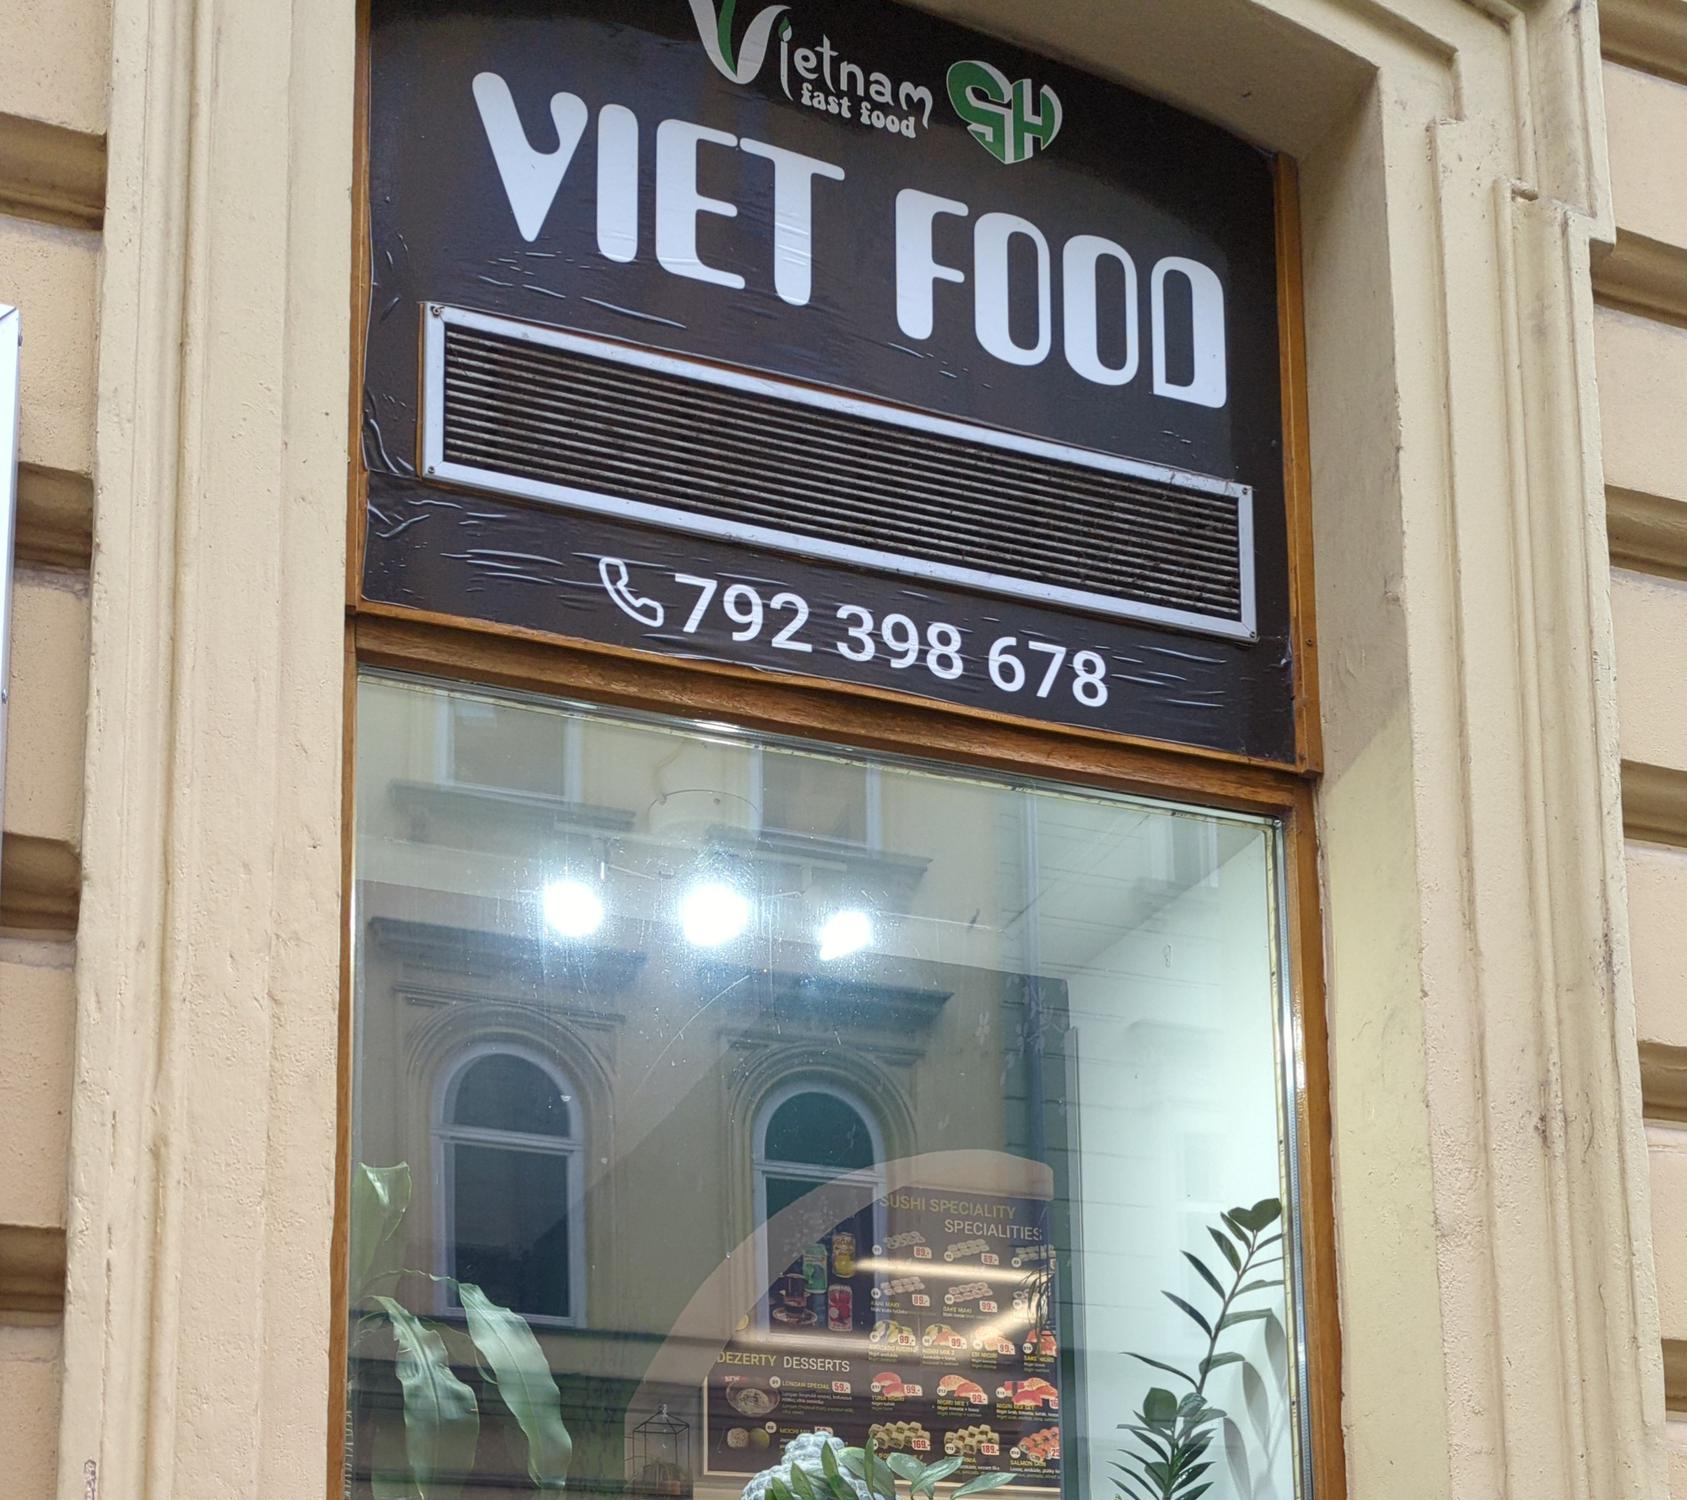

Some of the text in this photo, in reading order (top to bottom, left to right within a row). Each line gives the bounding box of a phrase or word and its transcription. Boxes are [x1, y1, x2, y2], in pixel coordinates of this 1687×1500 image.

[688, 0, 934, 129] Vietnam
[799, 84, 917, 139] fast food
[472, 73, 1227, 409] VIET FOOD
[674, 574, 1110, 709] 792 398 678
[880, 1196, 1016, 1219] SUSHI SPECIALITY
[945, 1220, 1041, 1241] SPECIALITIES
[718, 1352, 850, 1372] DEZERTY DESSERTS
